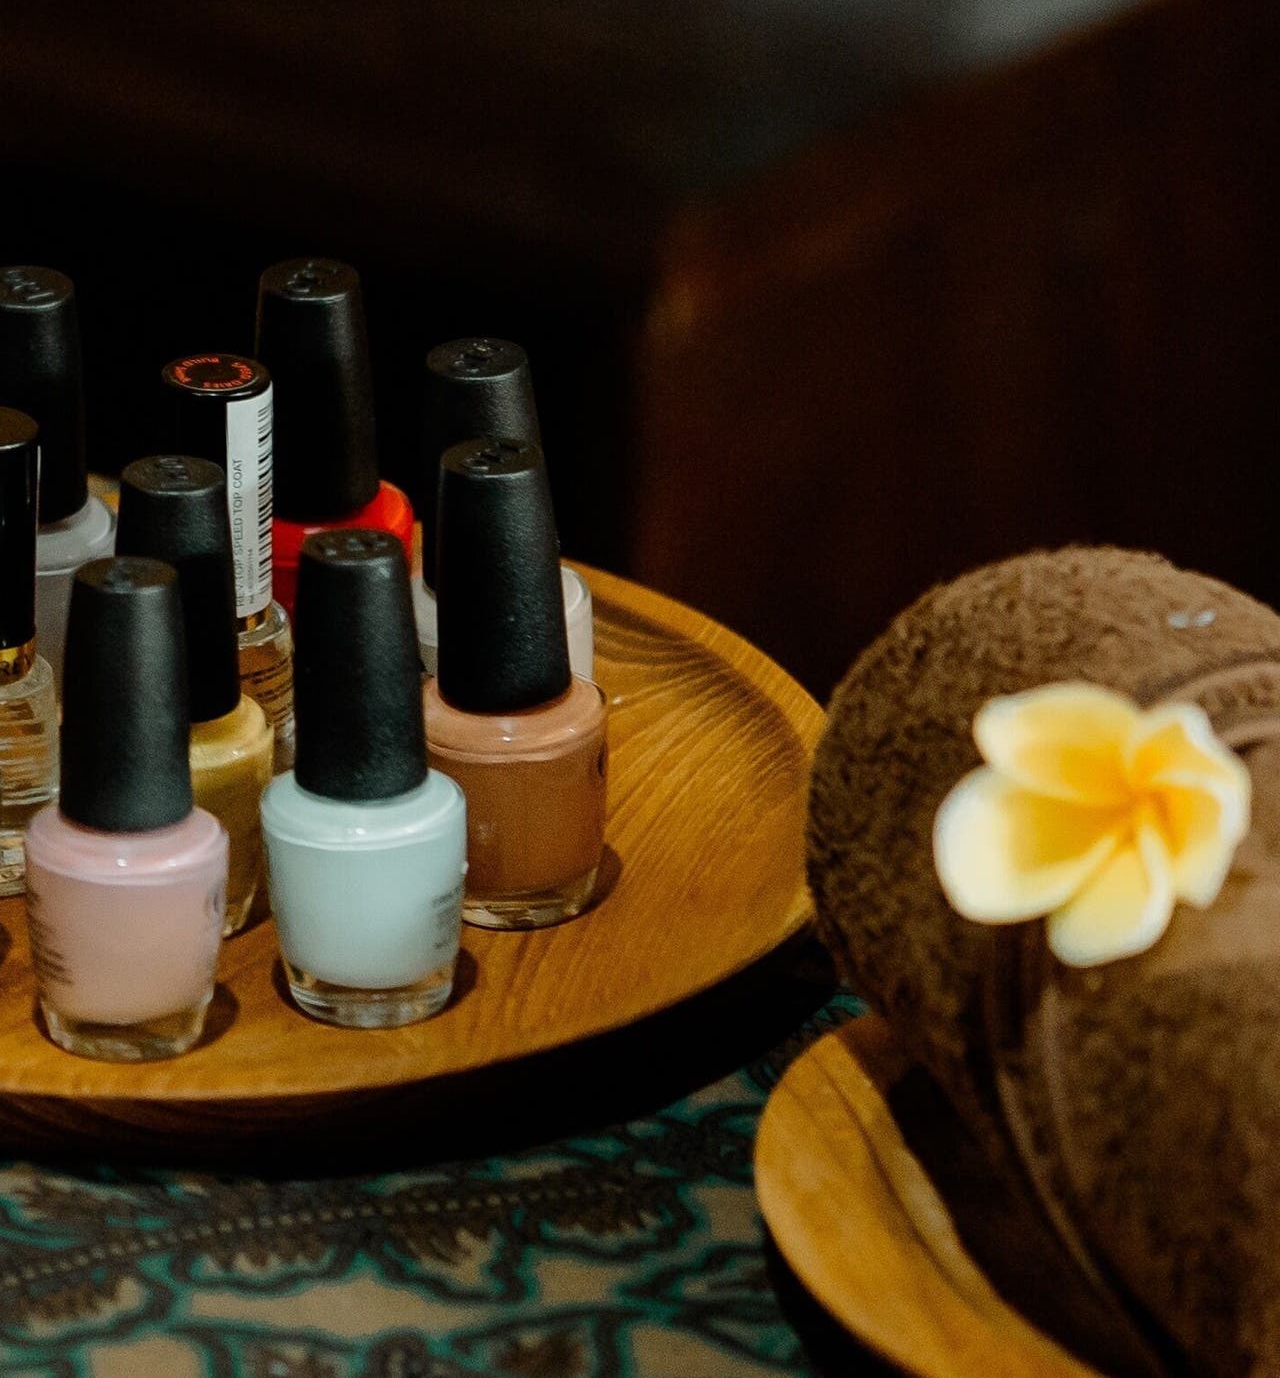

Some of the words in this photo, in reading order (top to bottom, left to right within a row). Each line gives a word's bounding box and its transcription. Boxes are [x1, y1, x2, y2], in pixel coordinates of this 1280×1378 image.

[232, 459, 243, 489] COAT
[232, 492, 243, 515] TOP
[233, 517, 245, 556] SPEED
